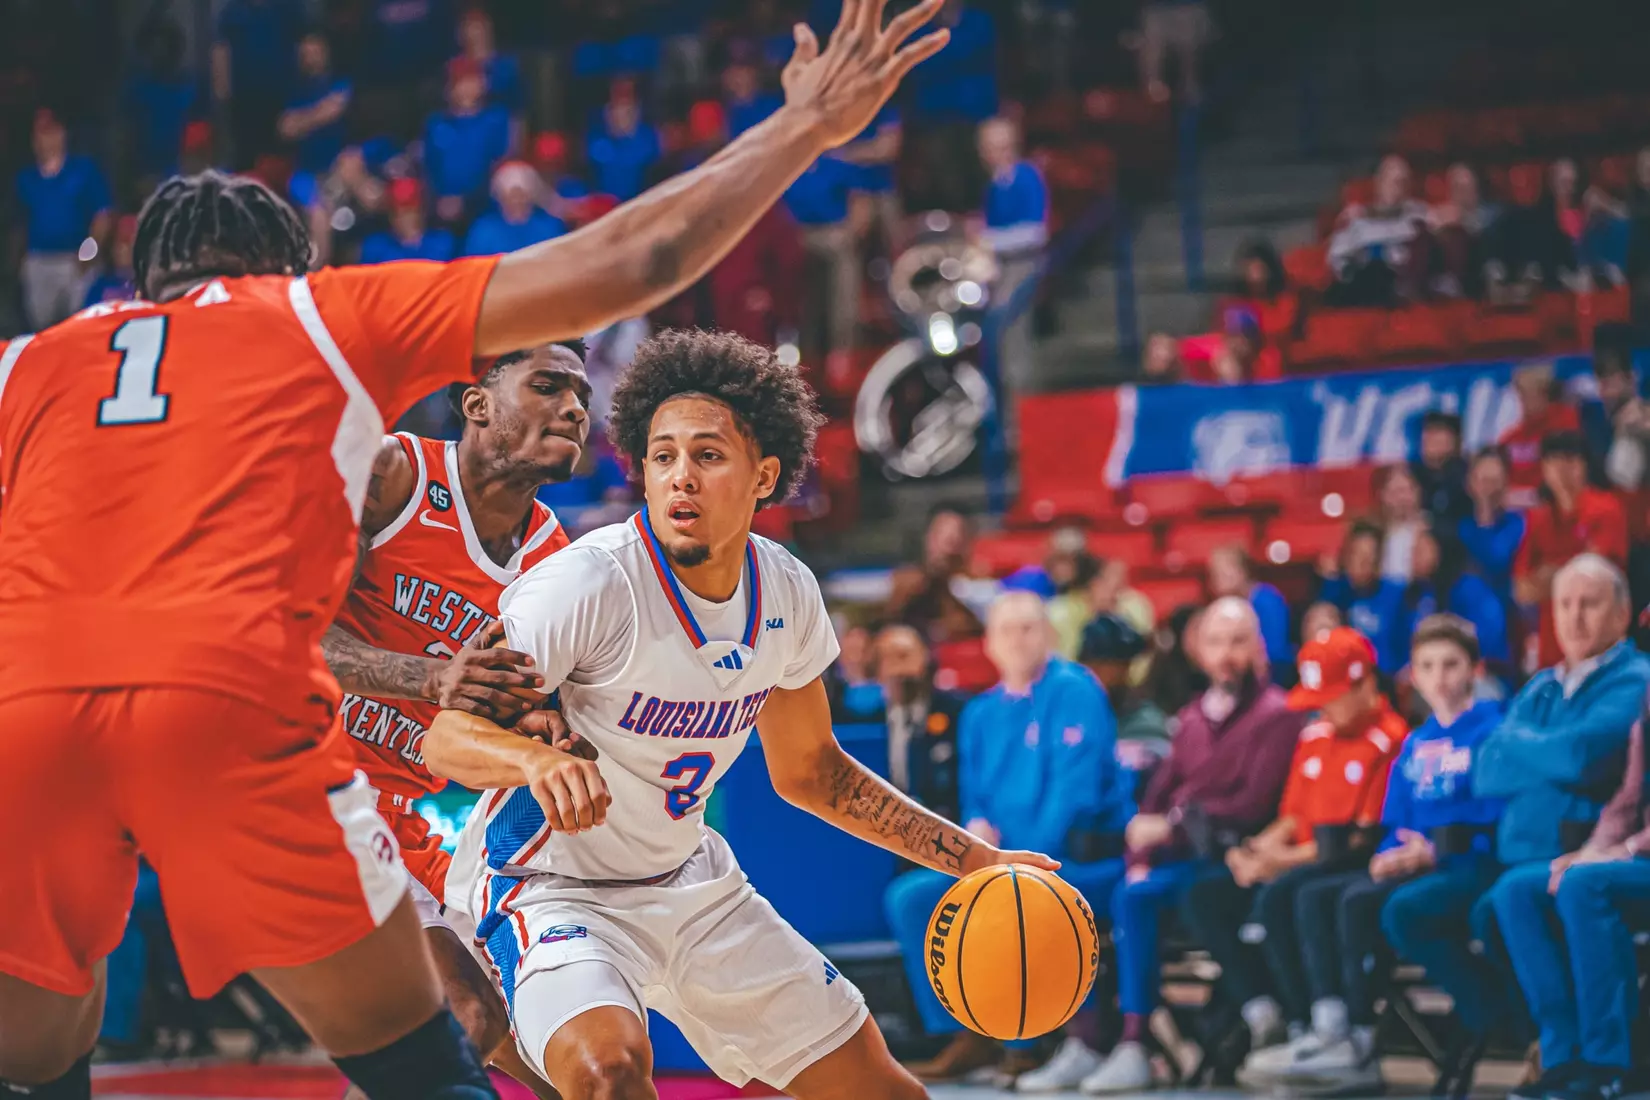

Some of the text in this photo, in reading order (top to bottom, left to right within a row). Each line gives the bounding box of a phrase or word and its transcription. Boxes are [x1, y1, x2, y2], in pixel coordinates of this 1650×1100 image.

[96, 314, 170, 427] 1
[429, 484, 449, 509] 45
[617, 691, 740, 739] LOUISIANA
[930, 902, 962, 1014] Wilson
